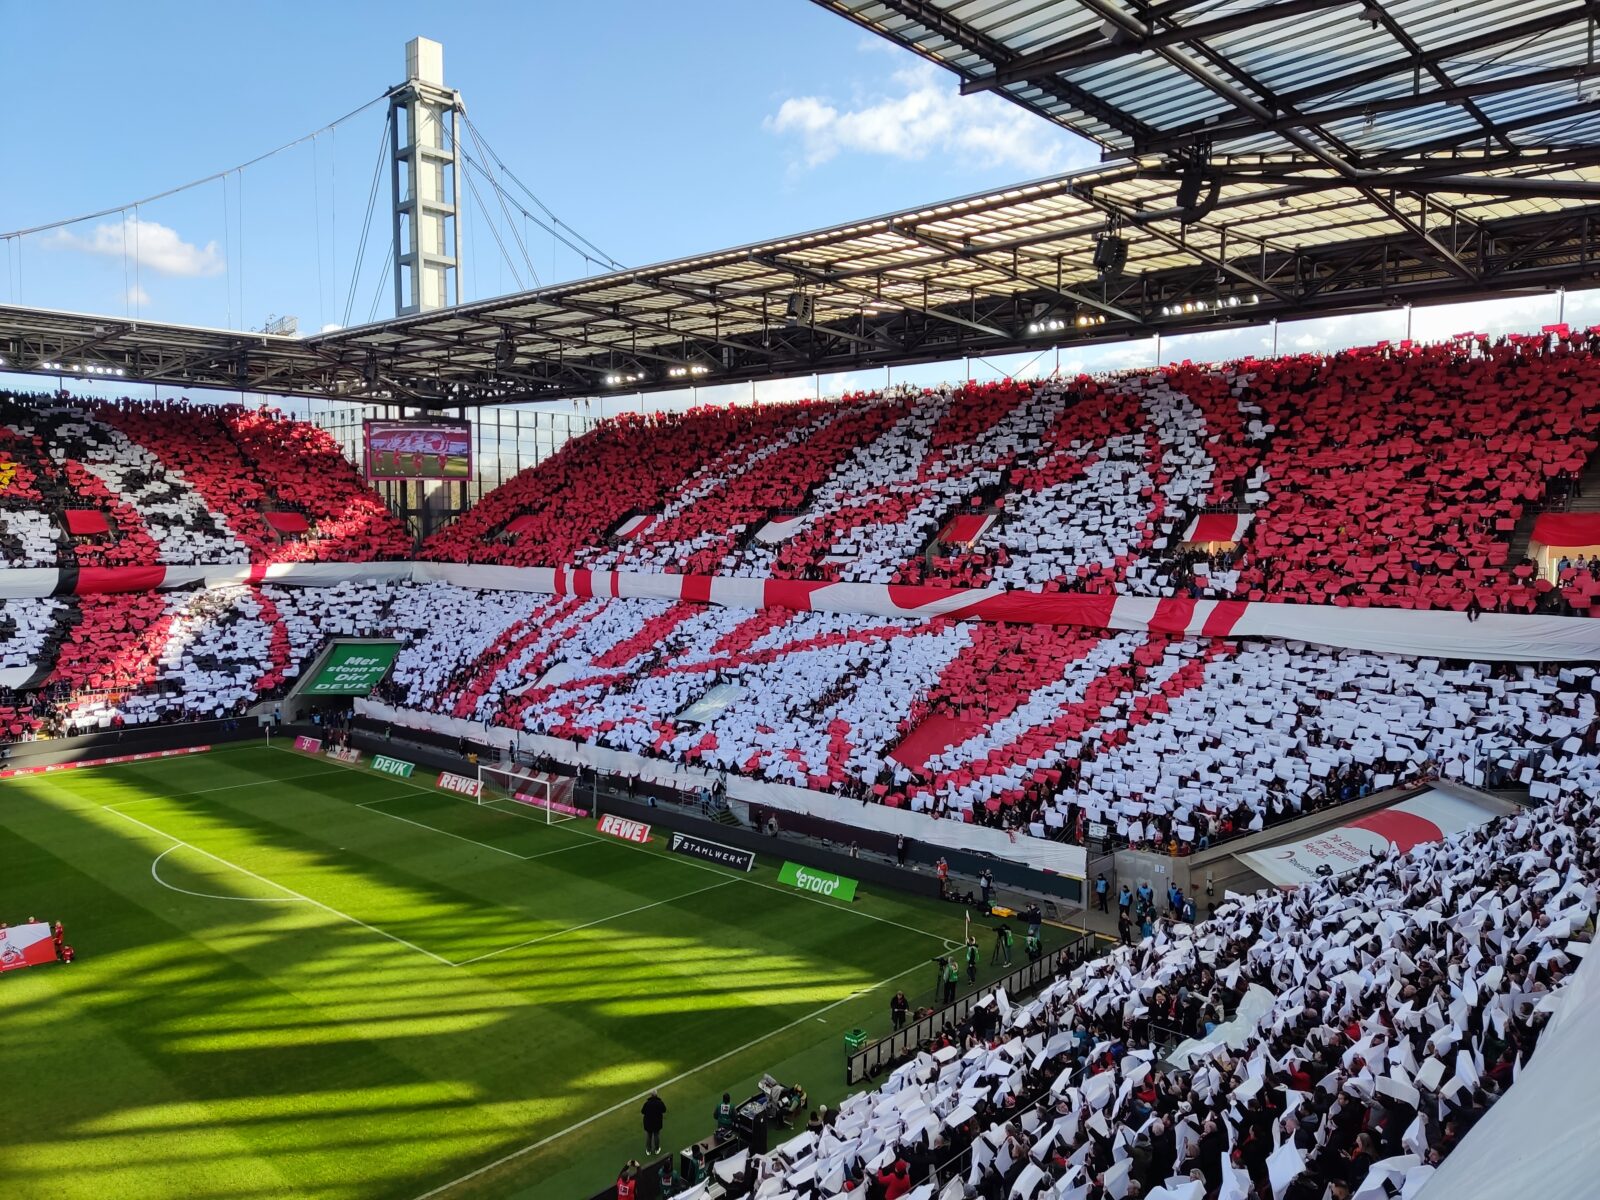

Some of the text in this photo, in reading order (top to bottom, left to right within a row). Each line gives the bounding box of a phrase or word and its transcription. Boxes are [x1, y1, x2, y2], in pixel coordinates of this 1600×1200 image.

[344, 656, 379, 665] Mer
[334, 673, 370, 681] Dir!
[373, 757, 408, 776] DEVK
[439, 774, 475, 795] REWE
[600, 816, 644, 842] REWE
[682, 841, 743, 864] STAHLWERK
